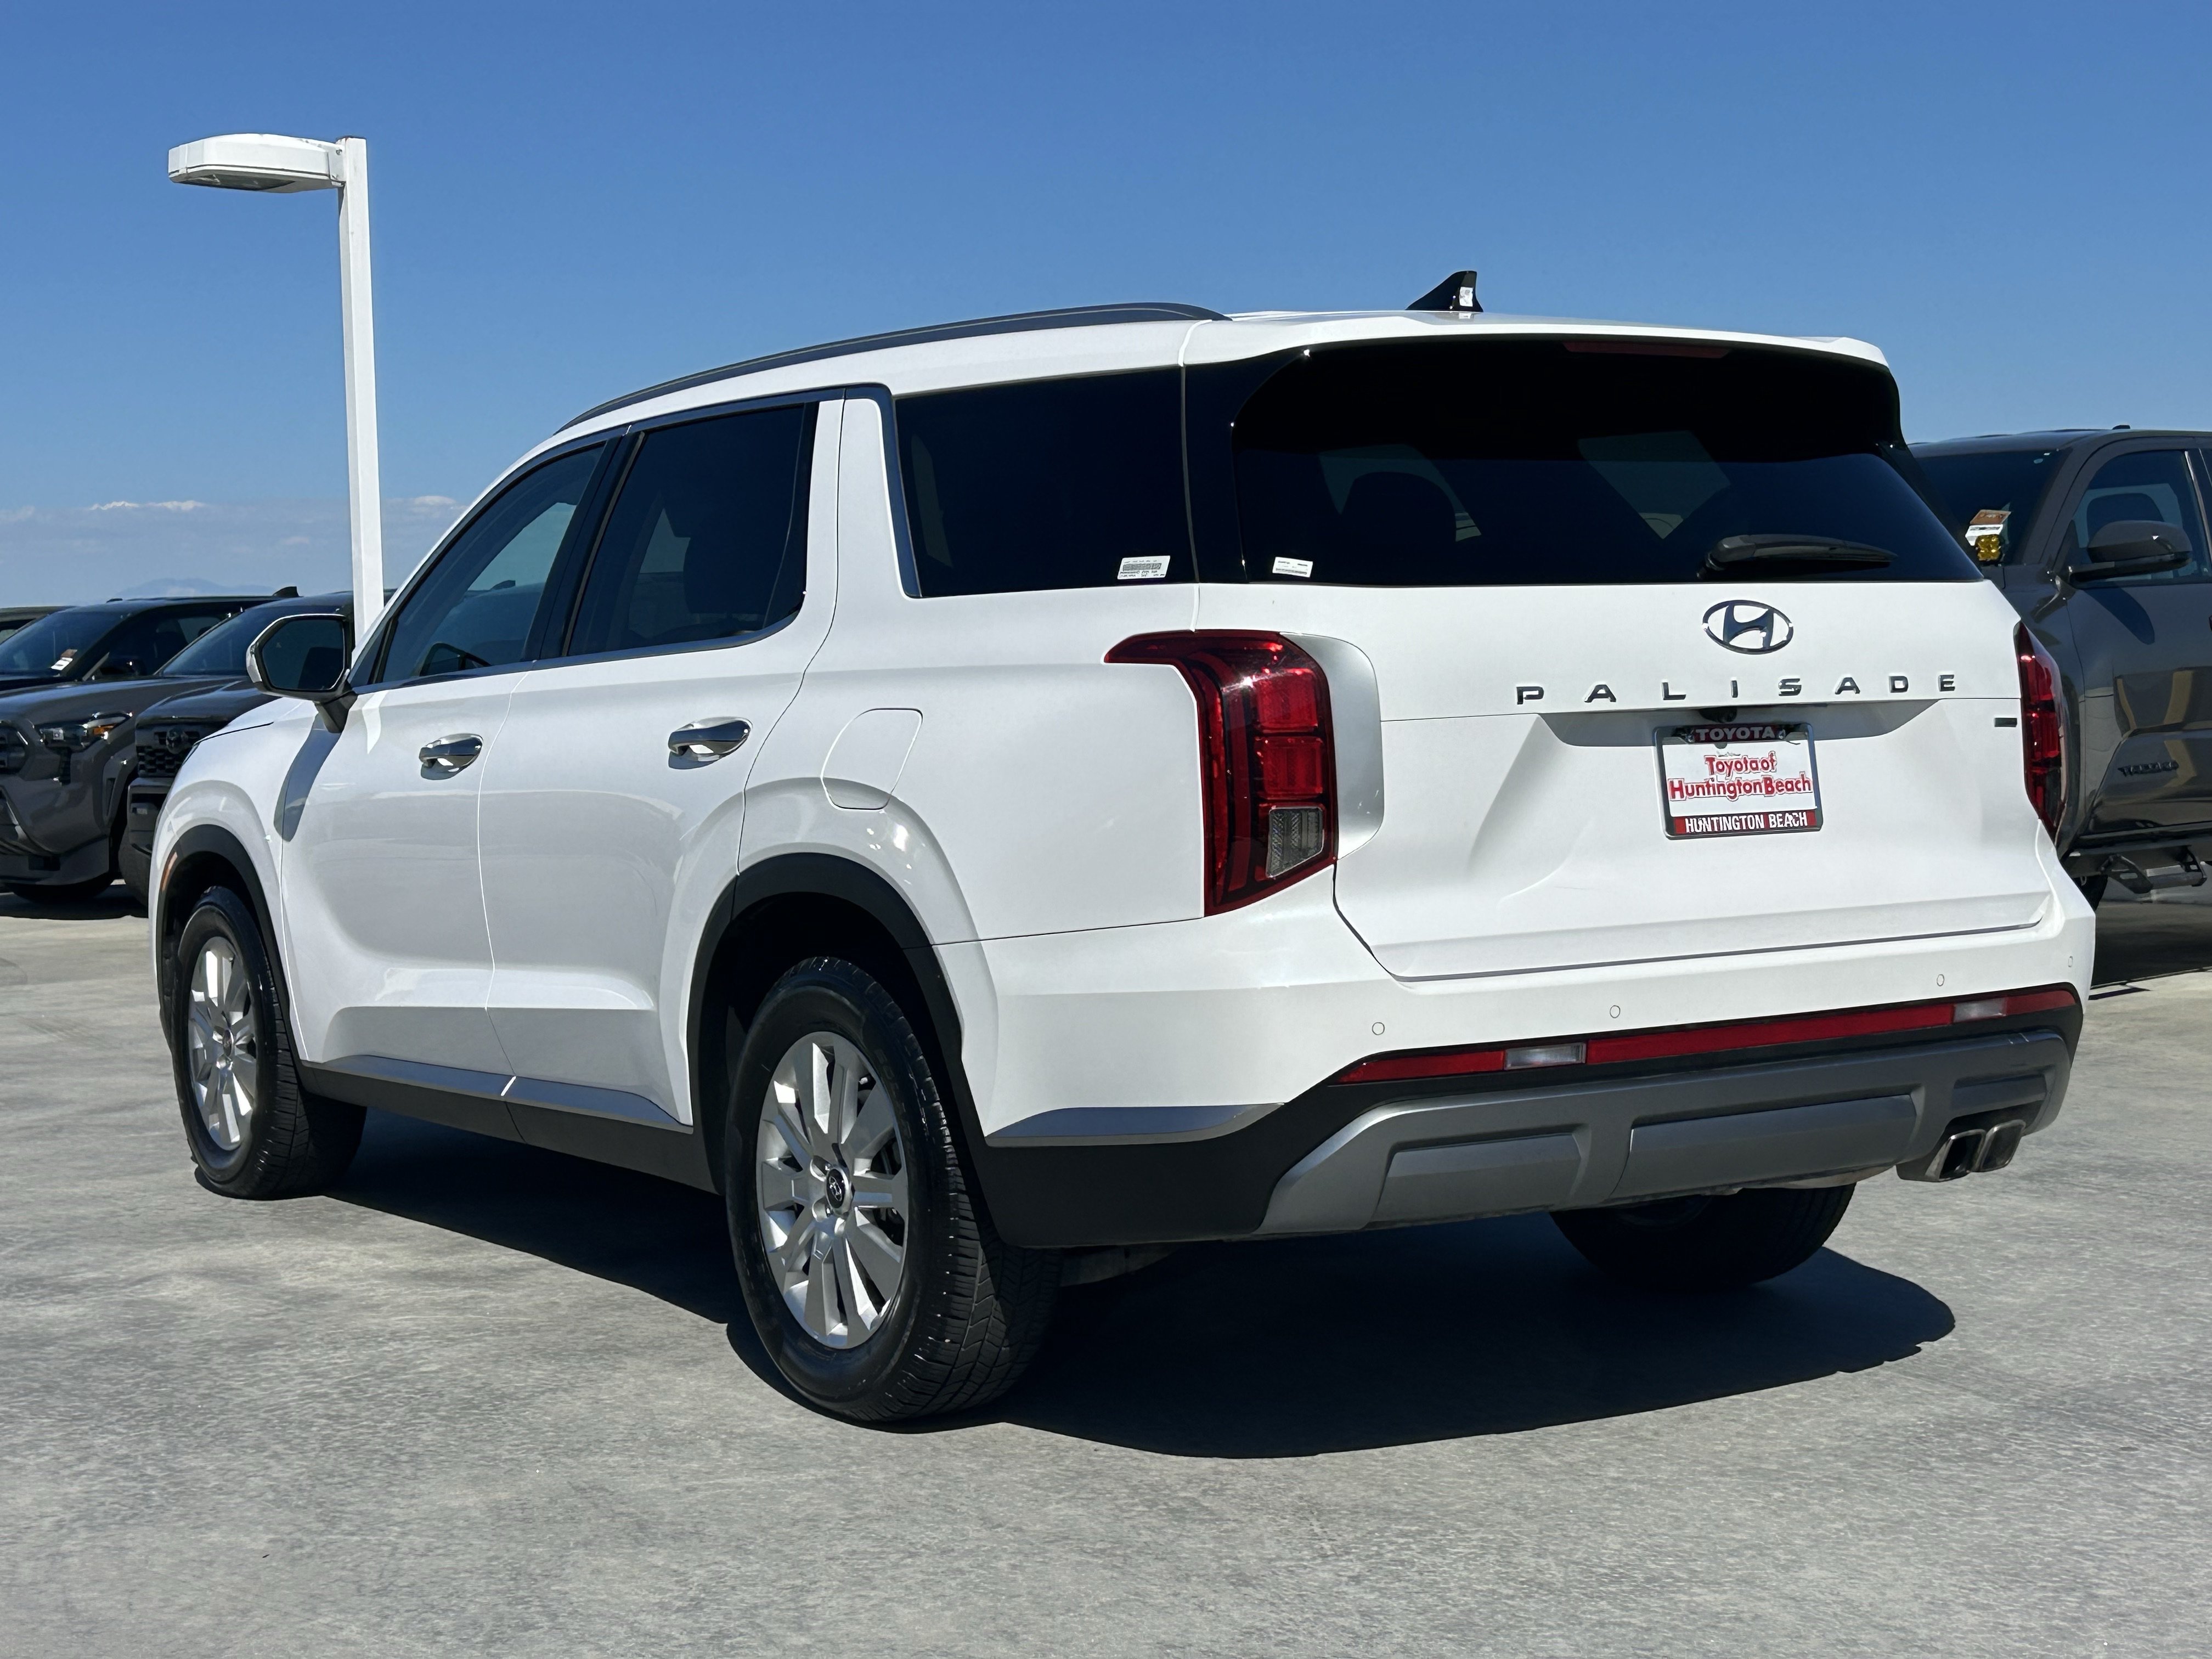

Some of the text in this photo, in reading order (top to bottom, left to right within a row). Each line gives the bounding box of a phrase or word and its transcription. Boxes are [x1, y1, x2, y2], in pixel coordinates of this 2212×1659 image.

[1516, 674, 1957, 705] PALISADE
[1696, 726, 1775, 741] TOYOTA
[1705, 752, 1776, 777] Toyota of
[1669, 772, 1812, 799] Huntington Beach
[1685, 811, 1808, 833] HUNTINGTON BEACH
